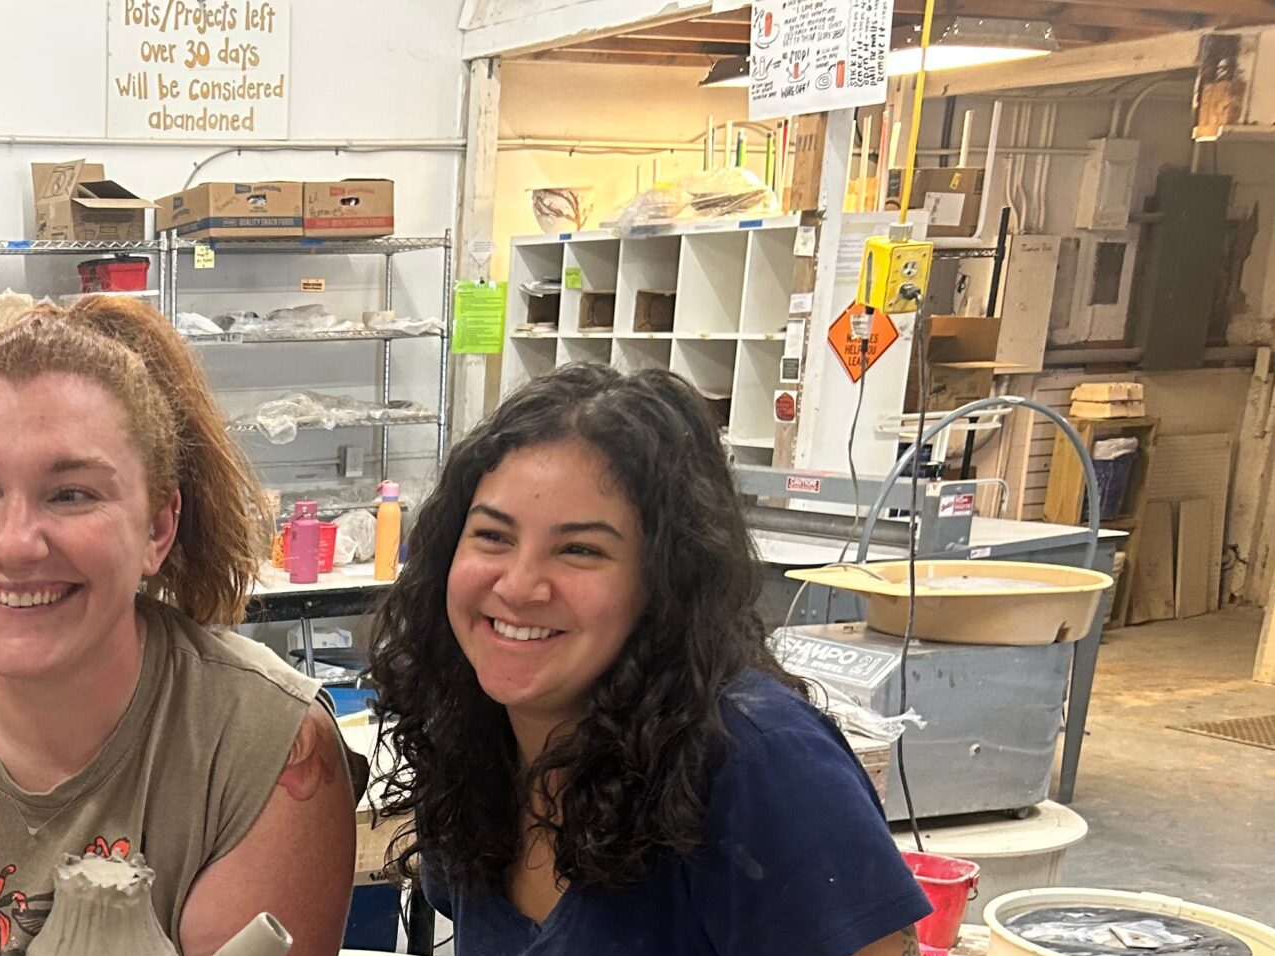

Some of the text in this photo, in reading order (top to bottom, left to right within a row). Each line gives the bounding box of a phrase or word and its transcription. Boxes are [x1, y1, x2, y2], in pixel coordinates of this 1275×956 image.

[124, 0, 275, 35] Pots/Projects left
[184, 40, 210, 68] 30
[218, 37, 260, 71] days
[158, 73, 180, 100] be
[148, 105, 255, 132] abandoned
